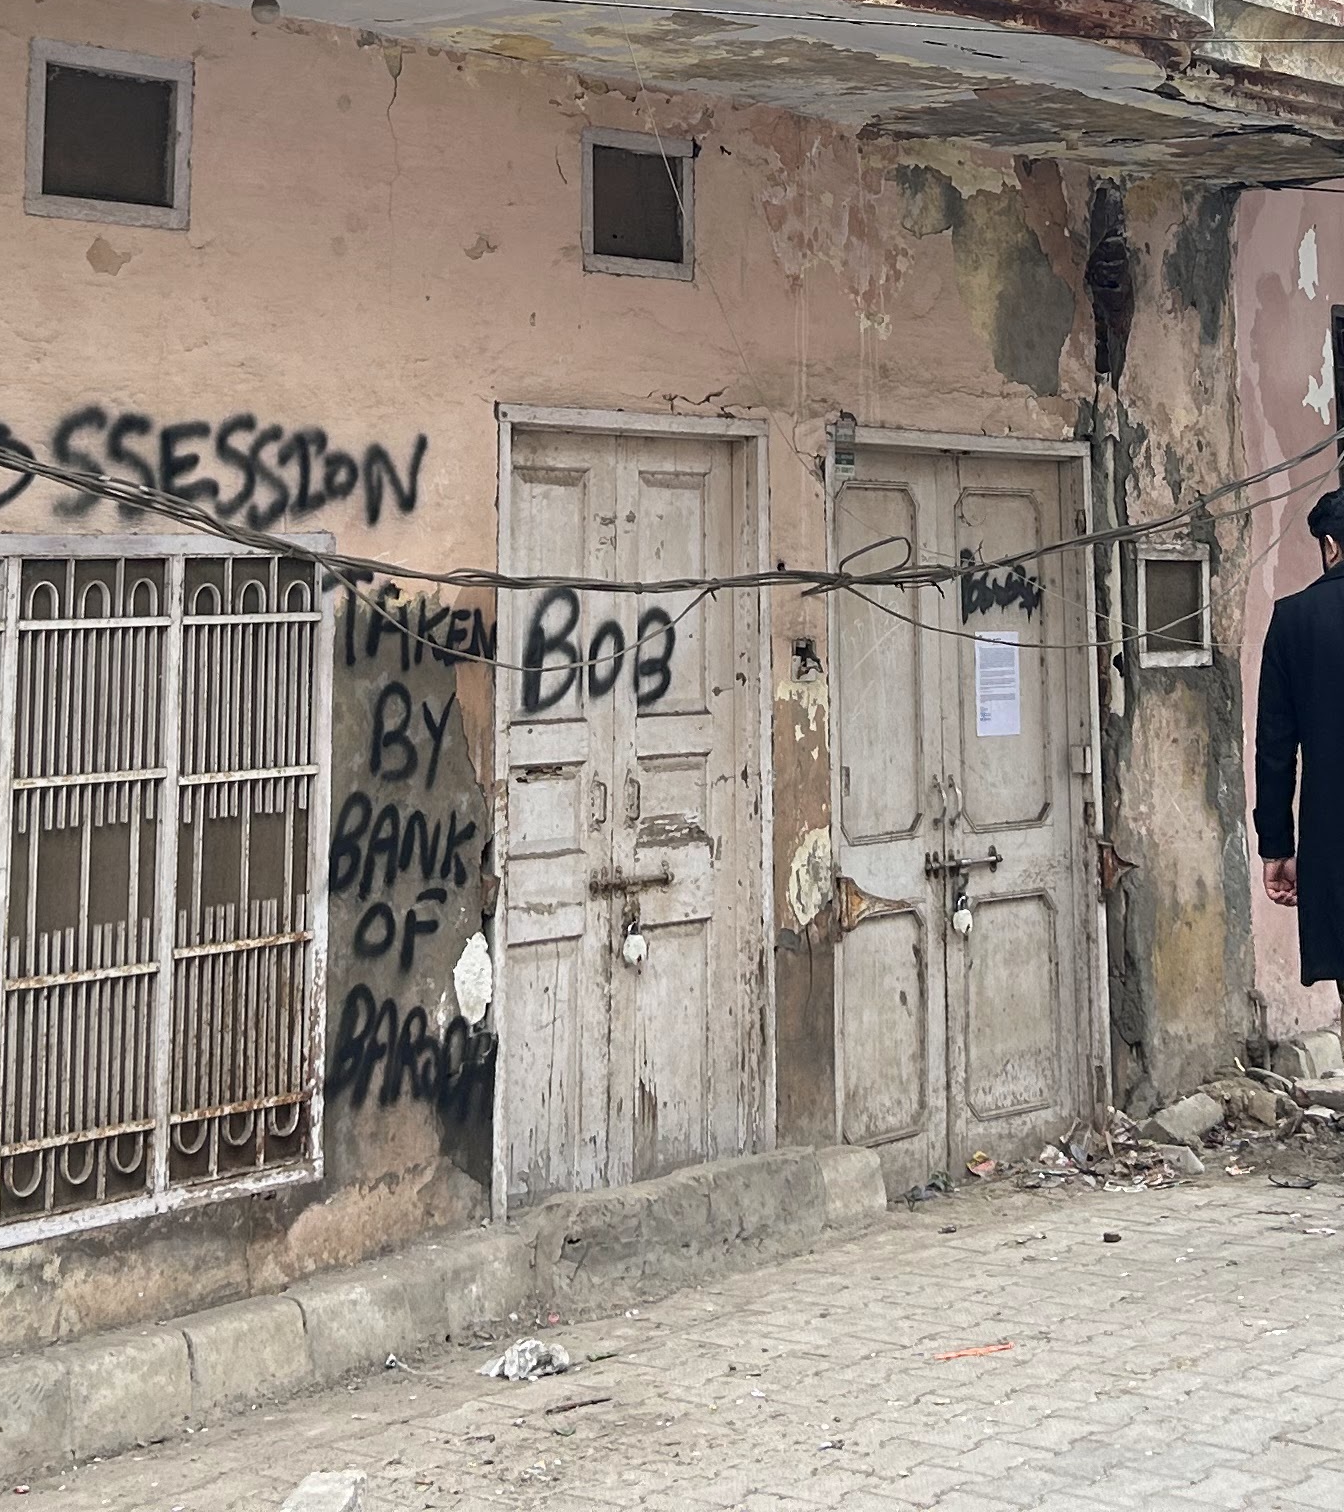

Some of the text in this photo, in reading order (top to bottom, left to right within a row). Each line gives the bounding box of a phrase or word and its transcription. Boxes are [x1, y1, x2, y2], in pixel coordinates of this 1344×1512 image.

[322, 568, 497, 673] TAKEN
[521, 586, 677, 715] BOB
[369, 680, 456, 792] BY
[329, 790, 476, 902] BANK
[354, 887, 448, 980] OF
